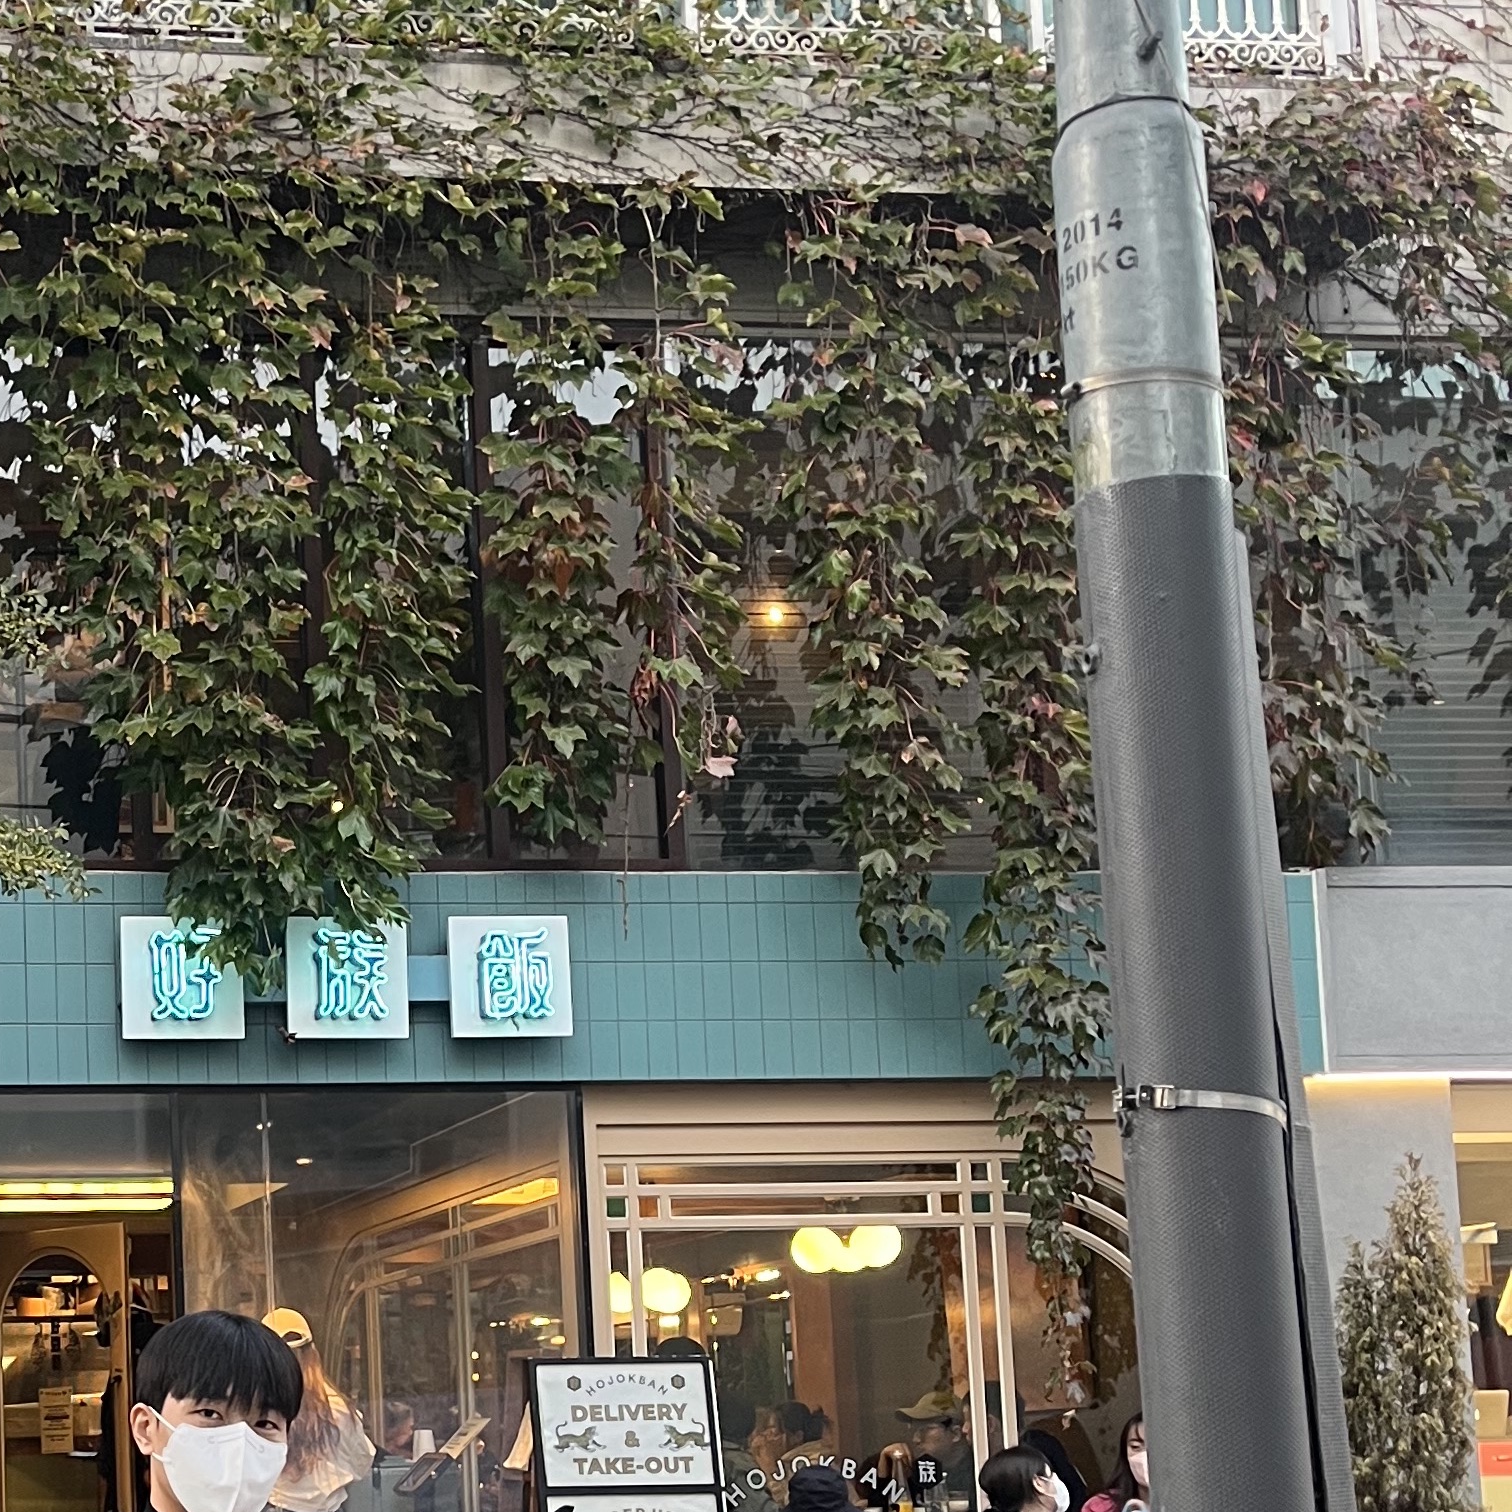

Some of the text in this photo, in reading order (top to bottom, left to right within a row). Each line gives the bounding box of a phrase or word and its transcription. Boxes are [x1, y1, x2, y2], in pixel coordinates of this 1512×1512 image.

[1062, 207, 1124, 253] 2014
[585, 1373, 669, 1397] HOJOKBAN
[570, 1403, 688, 1423] DELIVERY
[624, 1430, 641, 1448] &
[573, 1456, 694, 1476] TAKE-OUT
